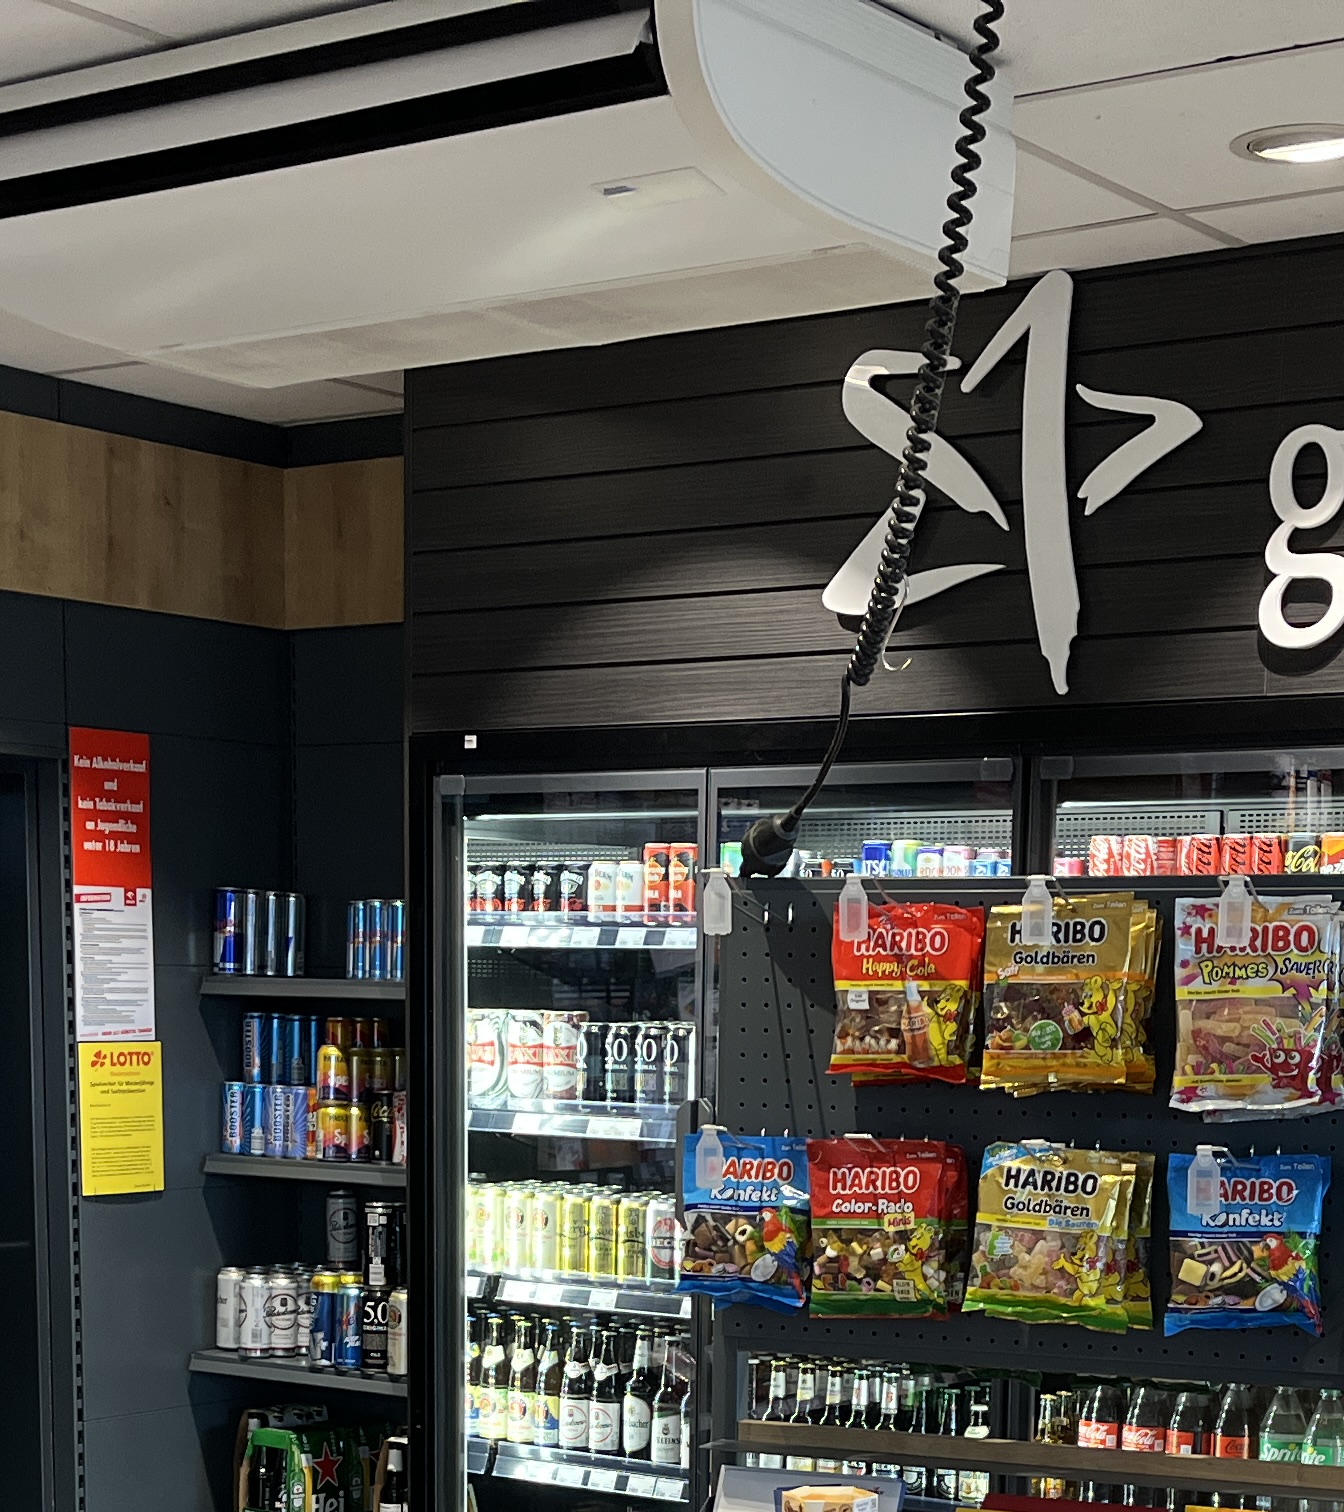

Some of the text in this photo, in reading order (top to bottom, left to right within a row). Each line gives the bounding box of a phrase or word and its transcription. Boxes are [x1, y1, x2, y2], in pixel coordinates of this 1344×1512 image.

[854, 929, 948, 956] HARIBO
[1009, 921, 1105, 944] HRIBO
[861, 957, 936, 977] Happy-Cola
[1013, 949, 1096, 966] Goldbären
[110, 1051, 151, 1067] LOTTO
[228, 1090, 238, 1139] BOOSTER
[272, 1093, 283, 1142] BOOSTER
[722, 1158, 793, 1182] ARIBO
[830, 1166, 919, 1193] HARIBO
[1003, 1167, 1099, 1196] HARIBO
[1213, 1178, 1294, 1204] ARIBO
[832, 1198, 913, 1214] Color-Rado
[1003, 1195, 1090, 1218] Goldbären
[363, 1301, 389, 1325] 5,0
